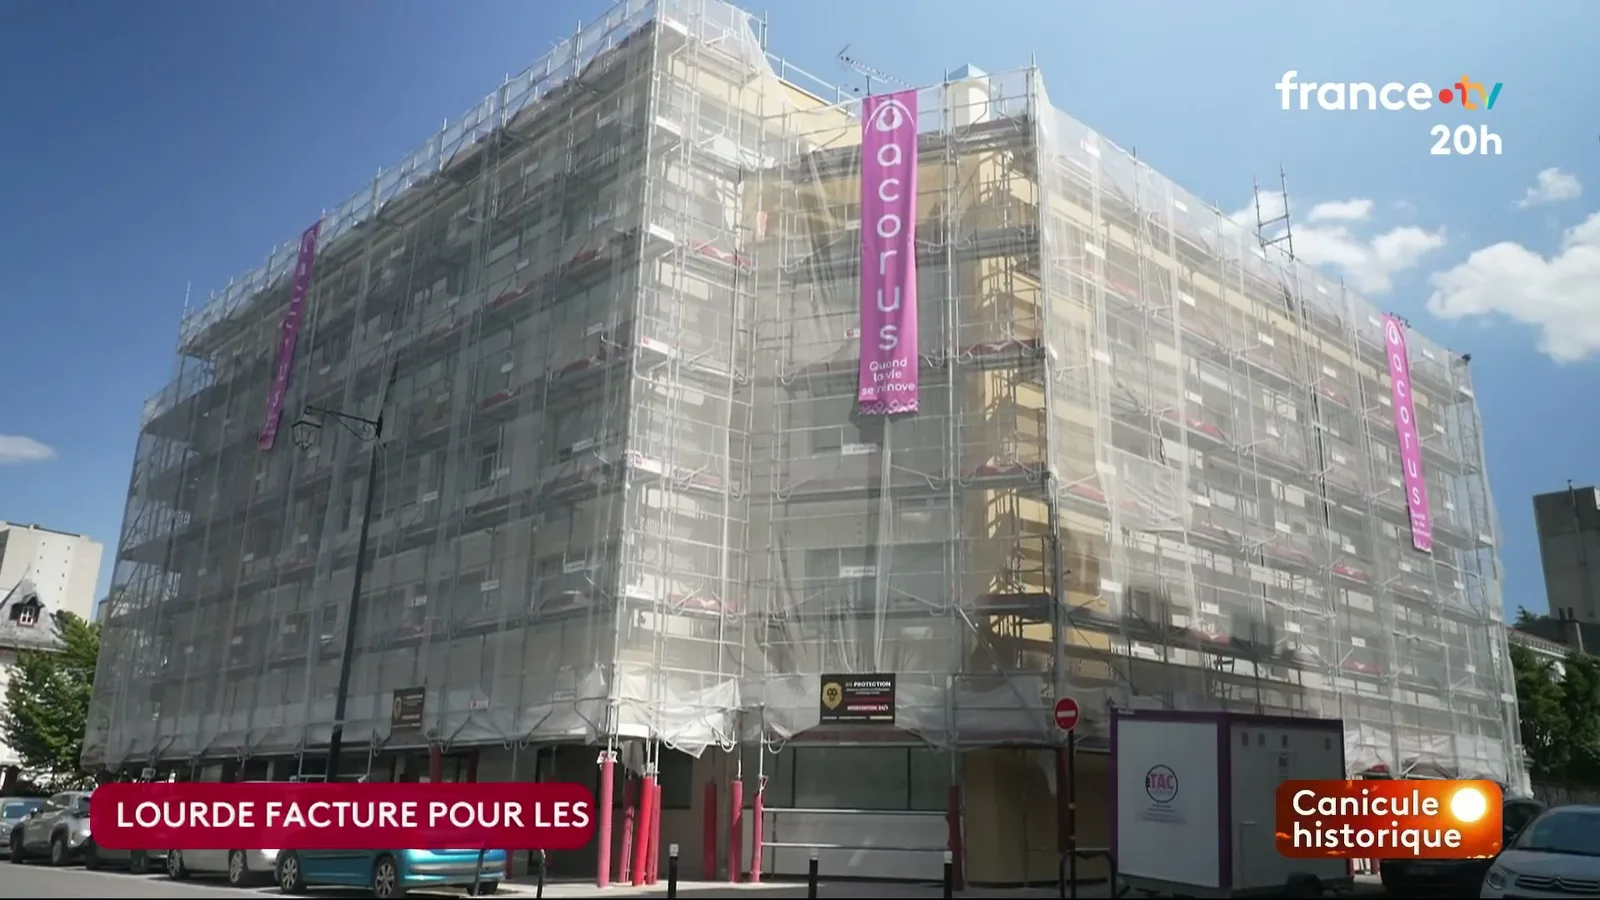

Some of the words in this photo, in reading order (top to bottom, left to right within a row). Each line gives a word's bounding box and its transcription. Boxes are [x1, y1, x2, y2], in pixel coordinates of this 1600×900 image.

[876, 143, 902, 351] acorus
[885, 369, 902, 379] vie
[861, 387, 874, 395] se
[1393, 354, 1421, 505] acorus
[1149, 773, 1174, 790] TAC
